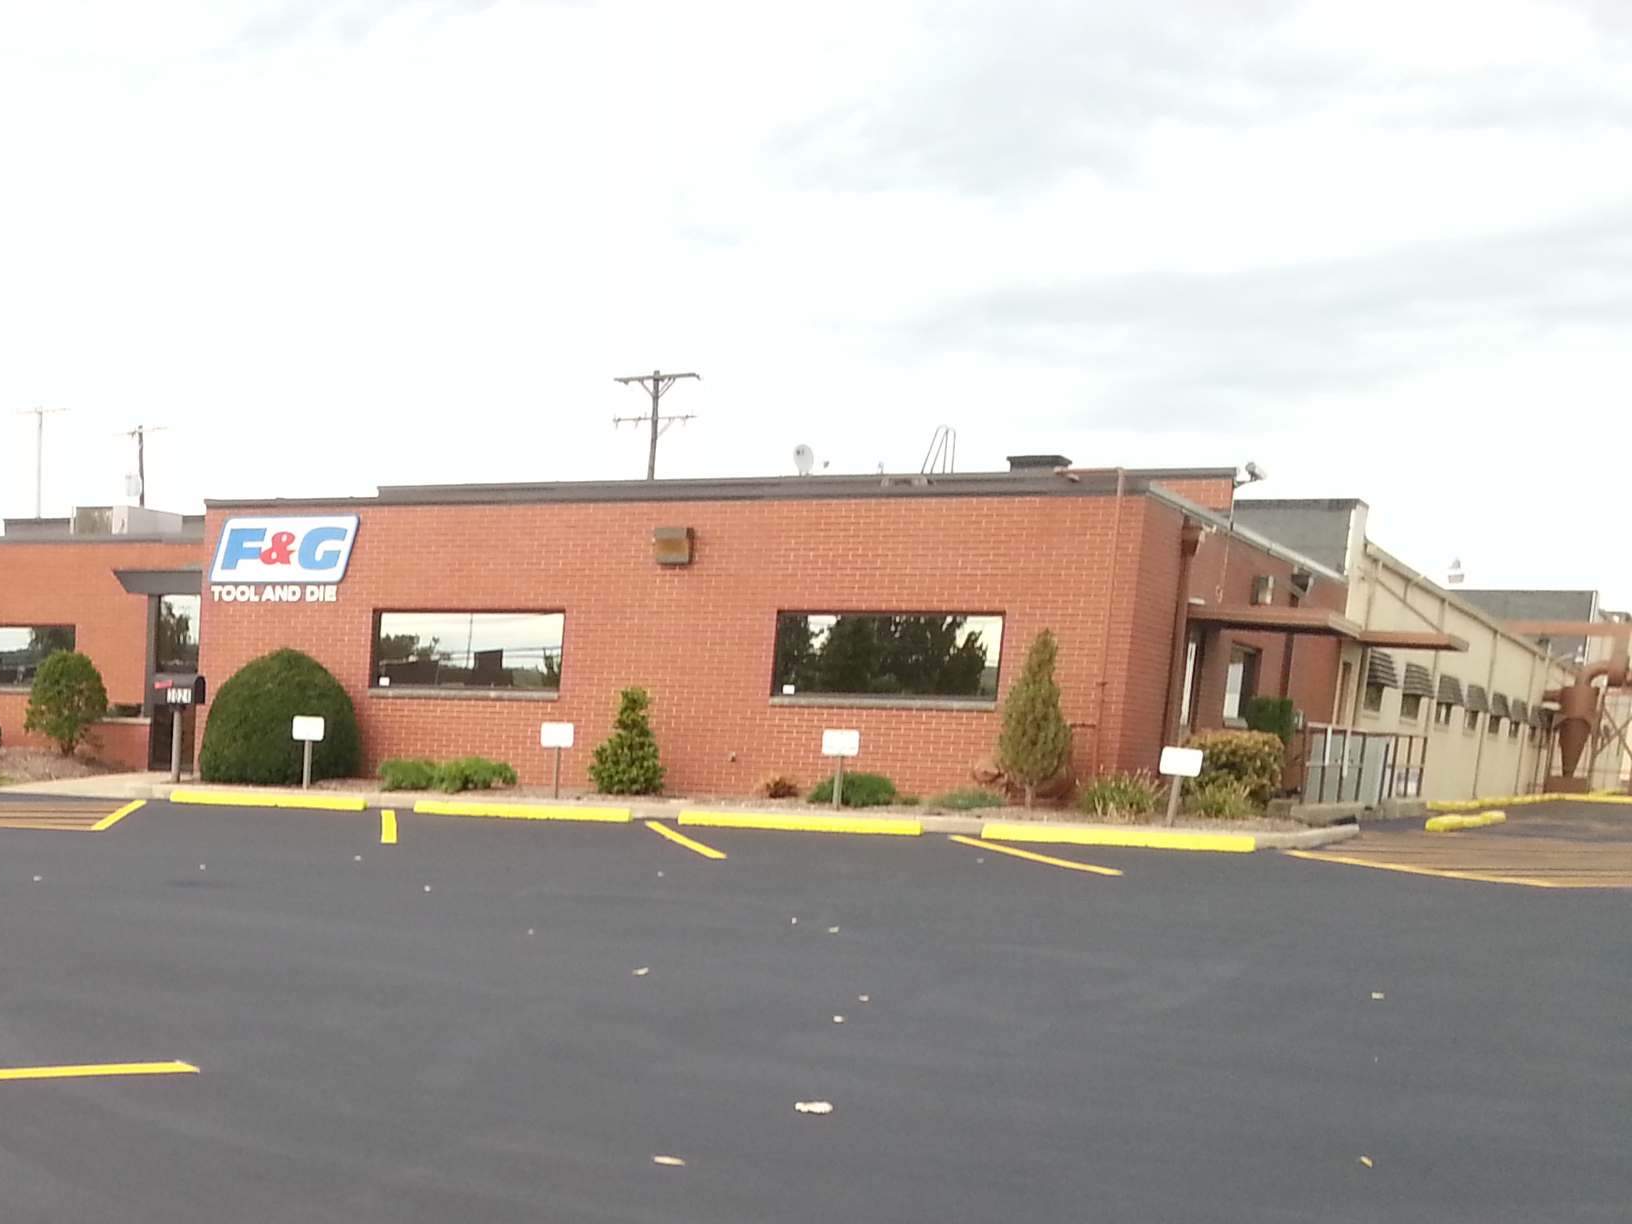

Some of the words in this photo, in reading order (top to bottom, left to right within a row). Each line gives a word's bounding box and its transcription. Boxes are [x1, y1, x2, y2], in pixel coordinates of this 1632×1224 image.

[221, 527, 348, 570] F&G
[211, 585, 259, 602] TOOL
[261, 585, 302, 602] AND
[305, 585, 337, 602] DIE
